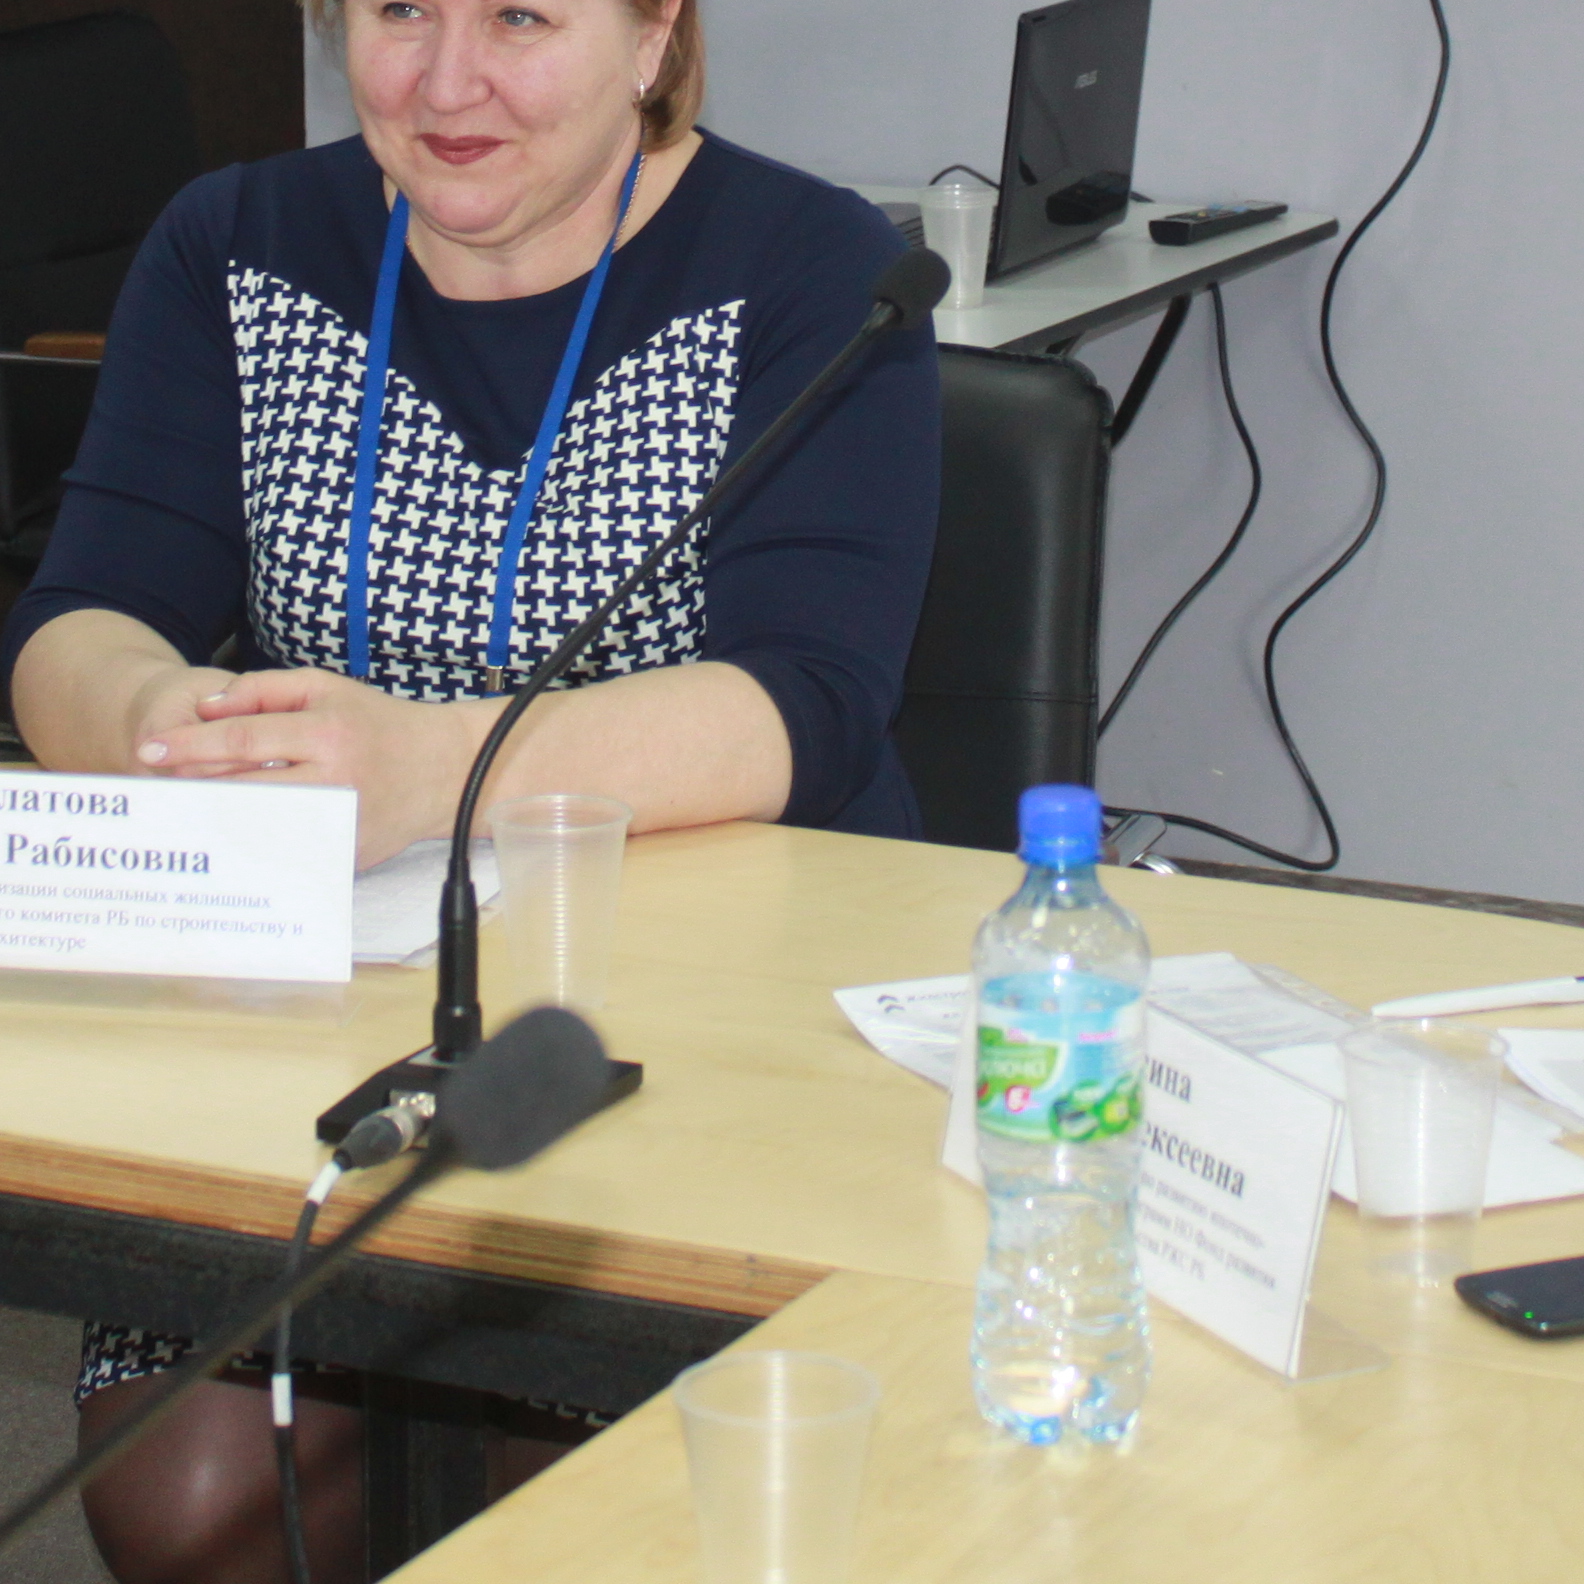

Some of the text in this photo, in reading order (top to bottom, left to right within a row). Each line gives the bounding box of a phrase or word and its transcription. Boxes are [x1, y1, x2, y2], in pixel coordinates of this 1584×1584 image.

[5, 833, 212, 875] Рабисовна
[63, 884, 168, 905] социальных
[20, 908, 101, 926] комитета
[106, 909, 131, 927] РБ
[135, 916, 156, 929] по
[160, 914, 287, 938] строительству
[293, 922, 304, 936] и
[1144, 1054, 1193, 1104] ина
